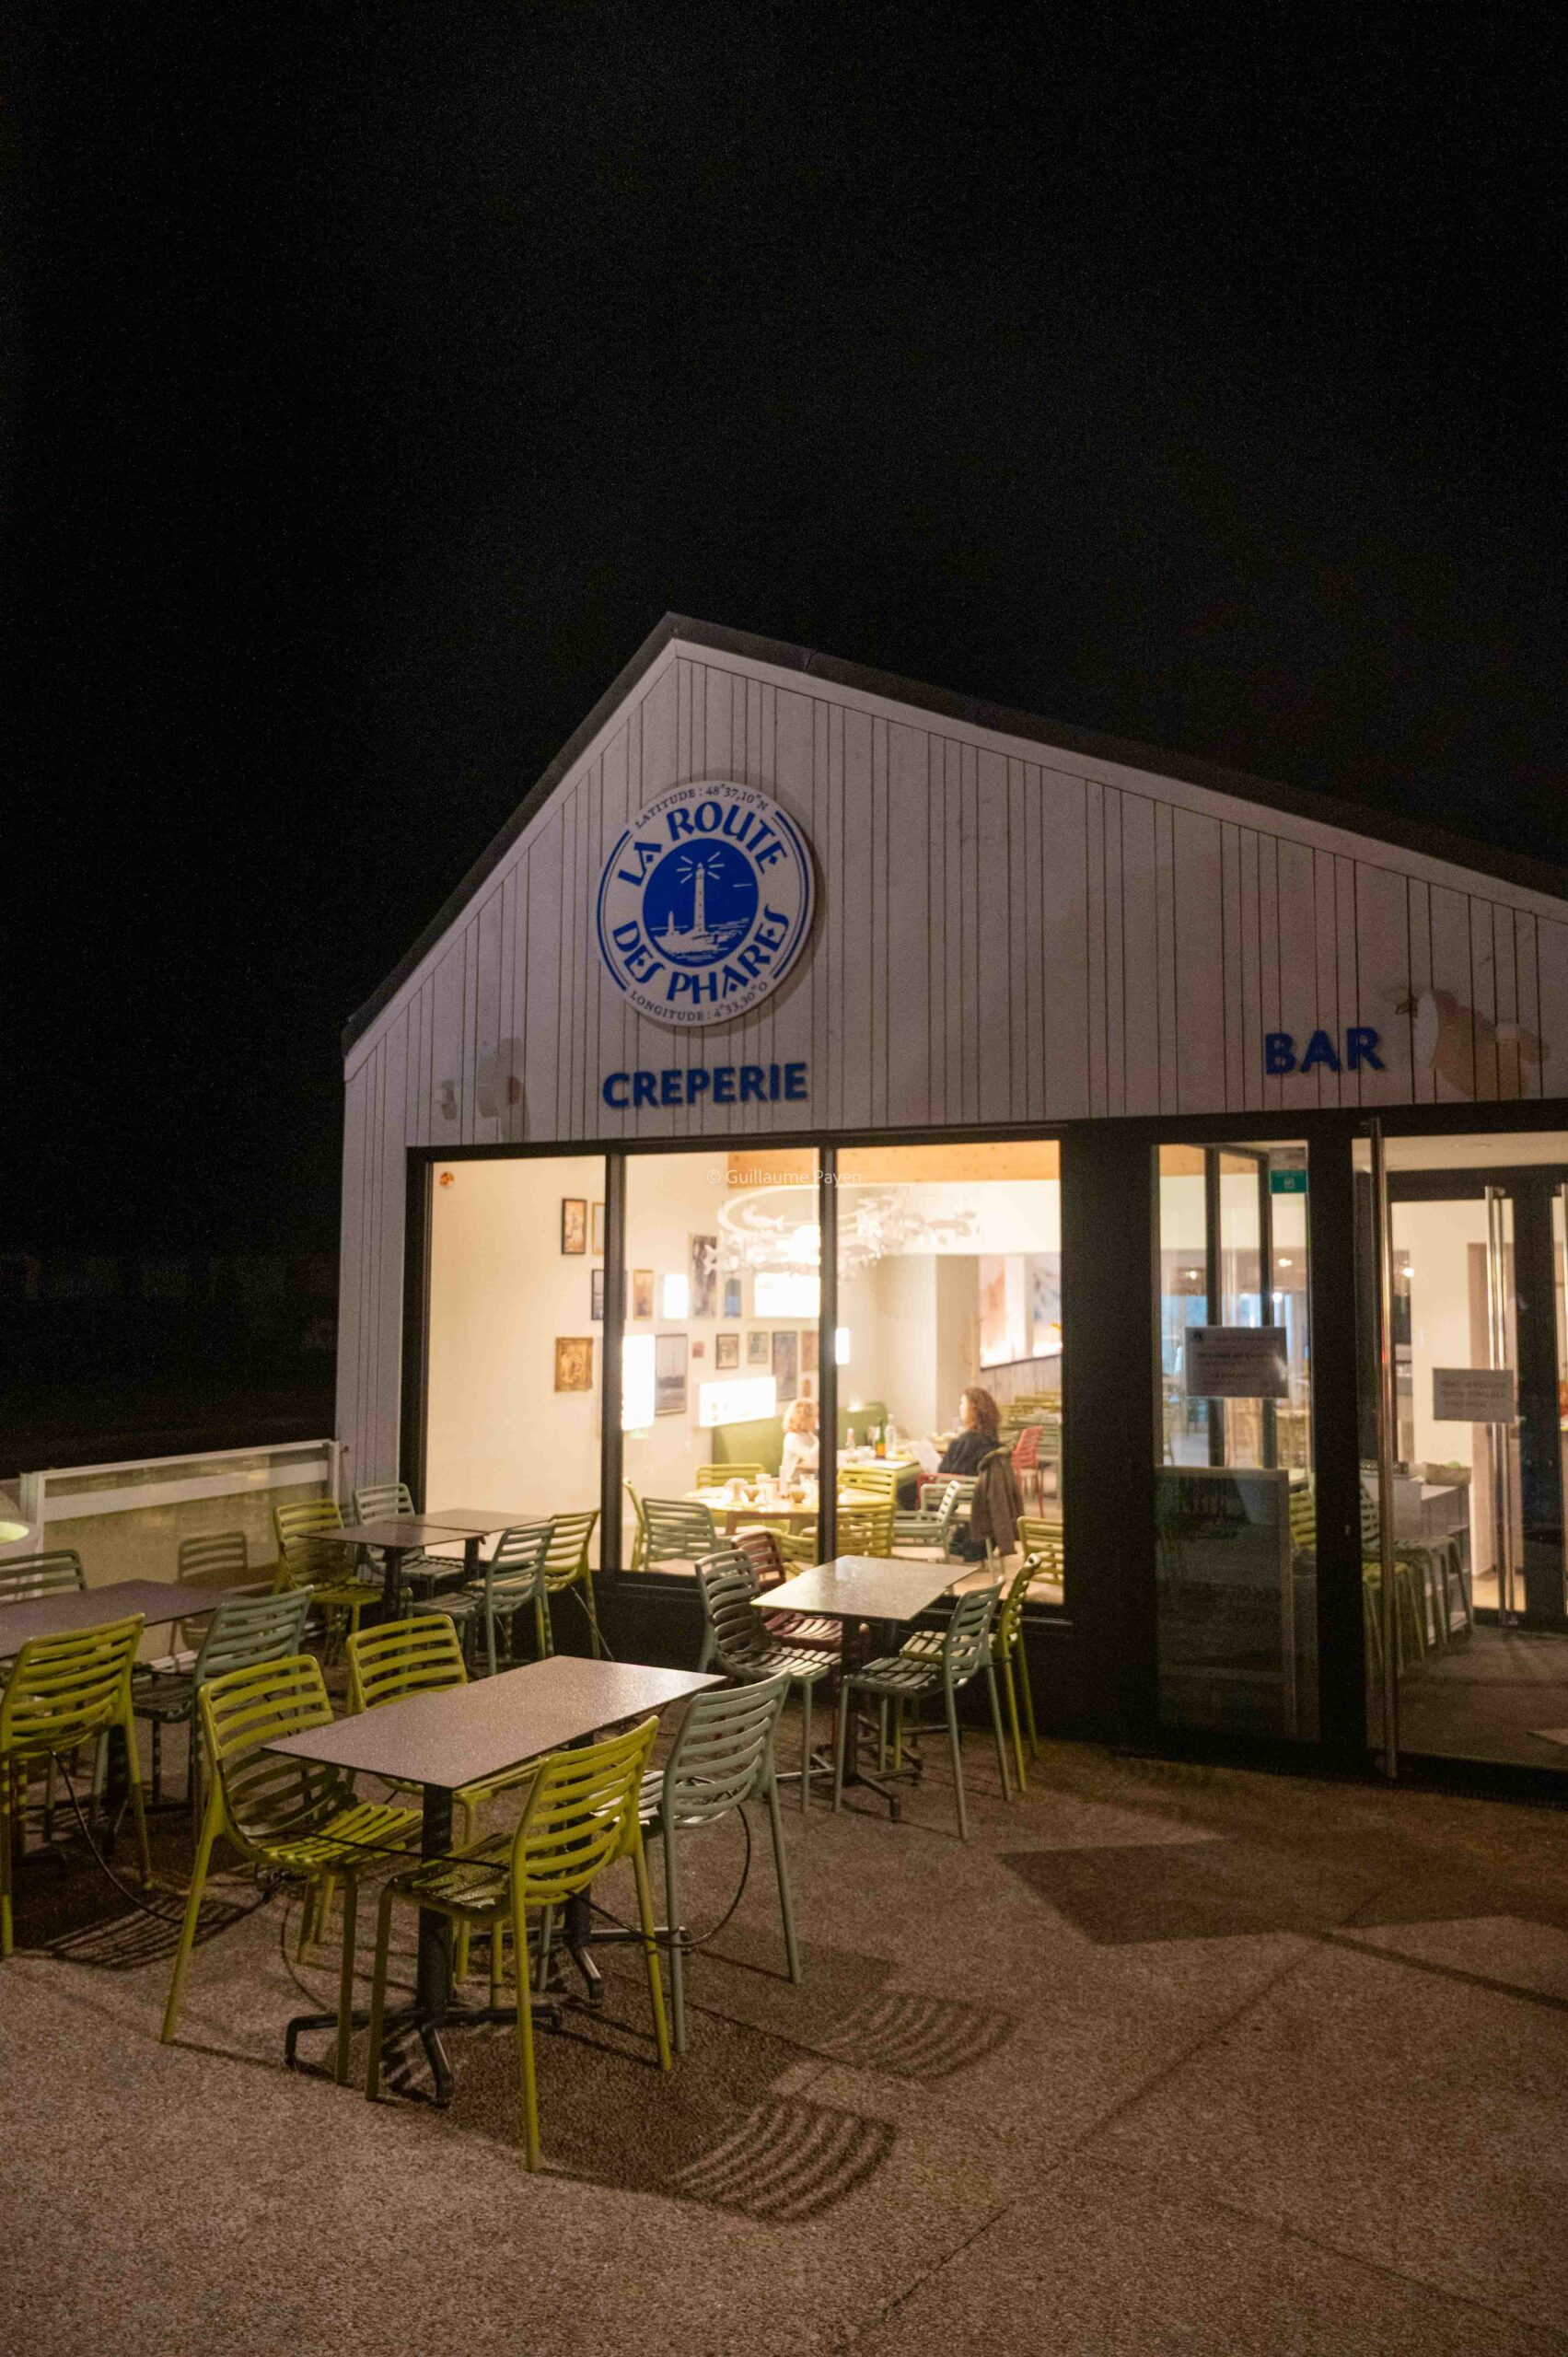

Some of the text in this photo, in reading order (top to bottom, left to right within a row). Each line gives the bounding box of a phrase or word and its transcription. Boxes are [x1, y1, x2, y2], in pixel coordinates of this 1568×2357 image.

[634, 789, 696, 829] LATITUDE
[618, 801, 788, 887] LA ROUTE
[612, 903, 790, 1004] DES PHARES
[630, 990, 704, 1022] LONGITUDE
[1264, 1027, 1386, 1075] BAR
[602, 1062, 809, 1109] CREPERIE
